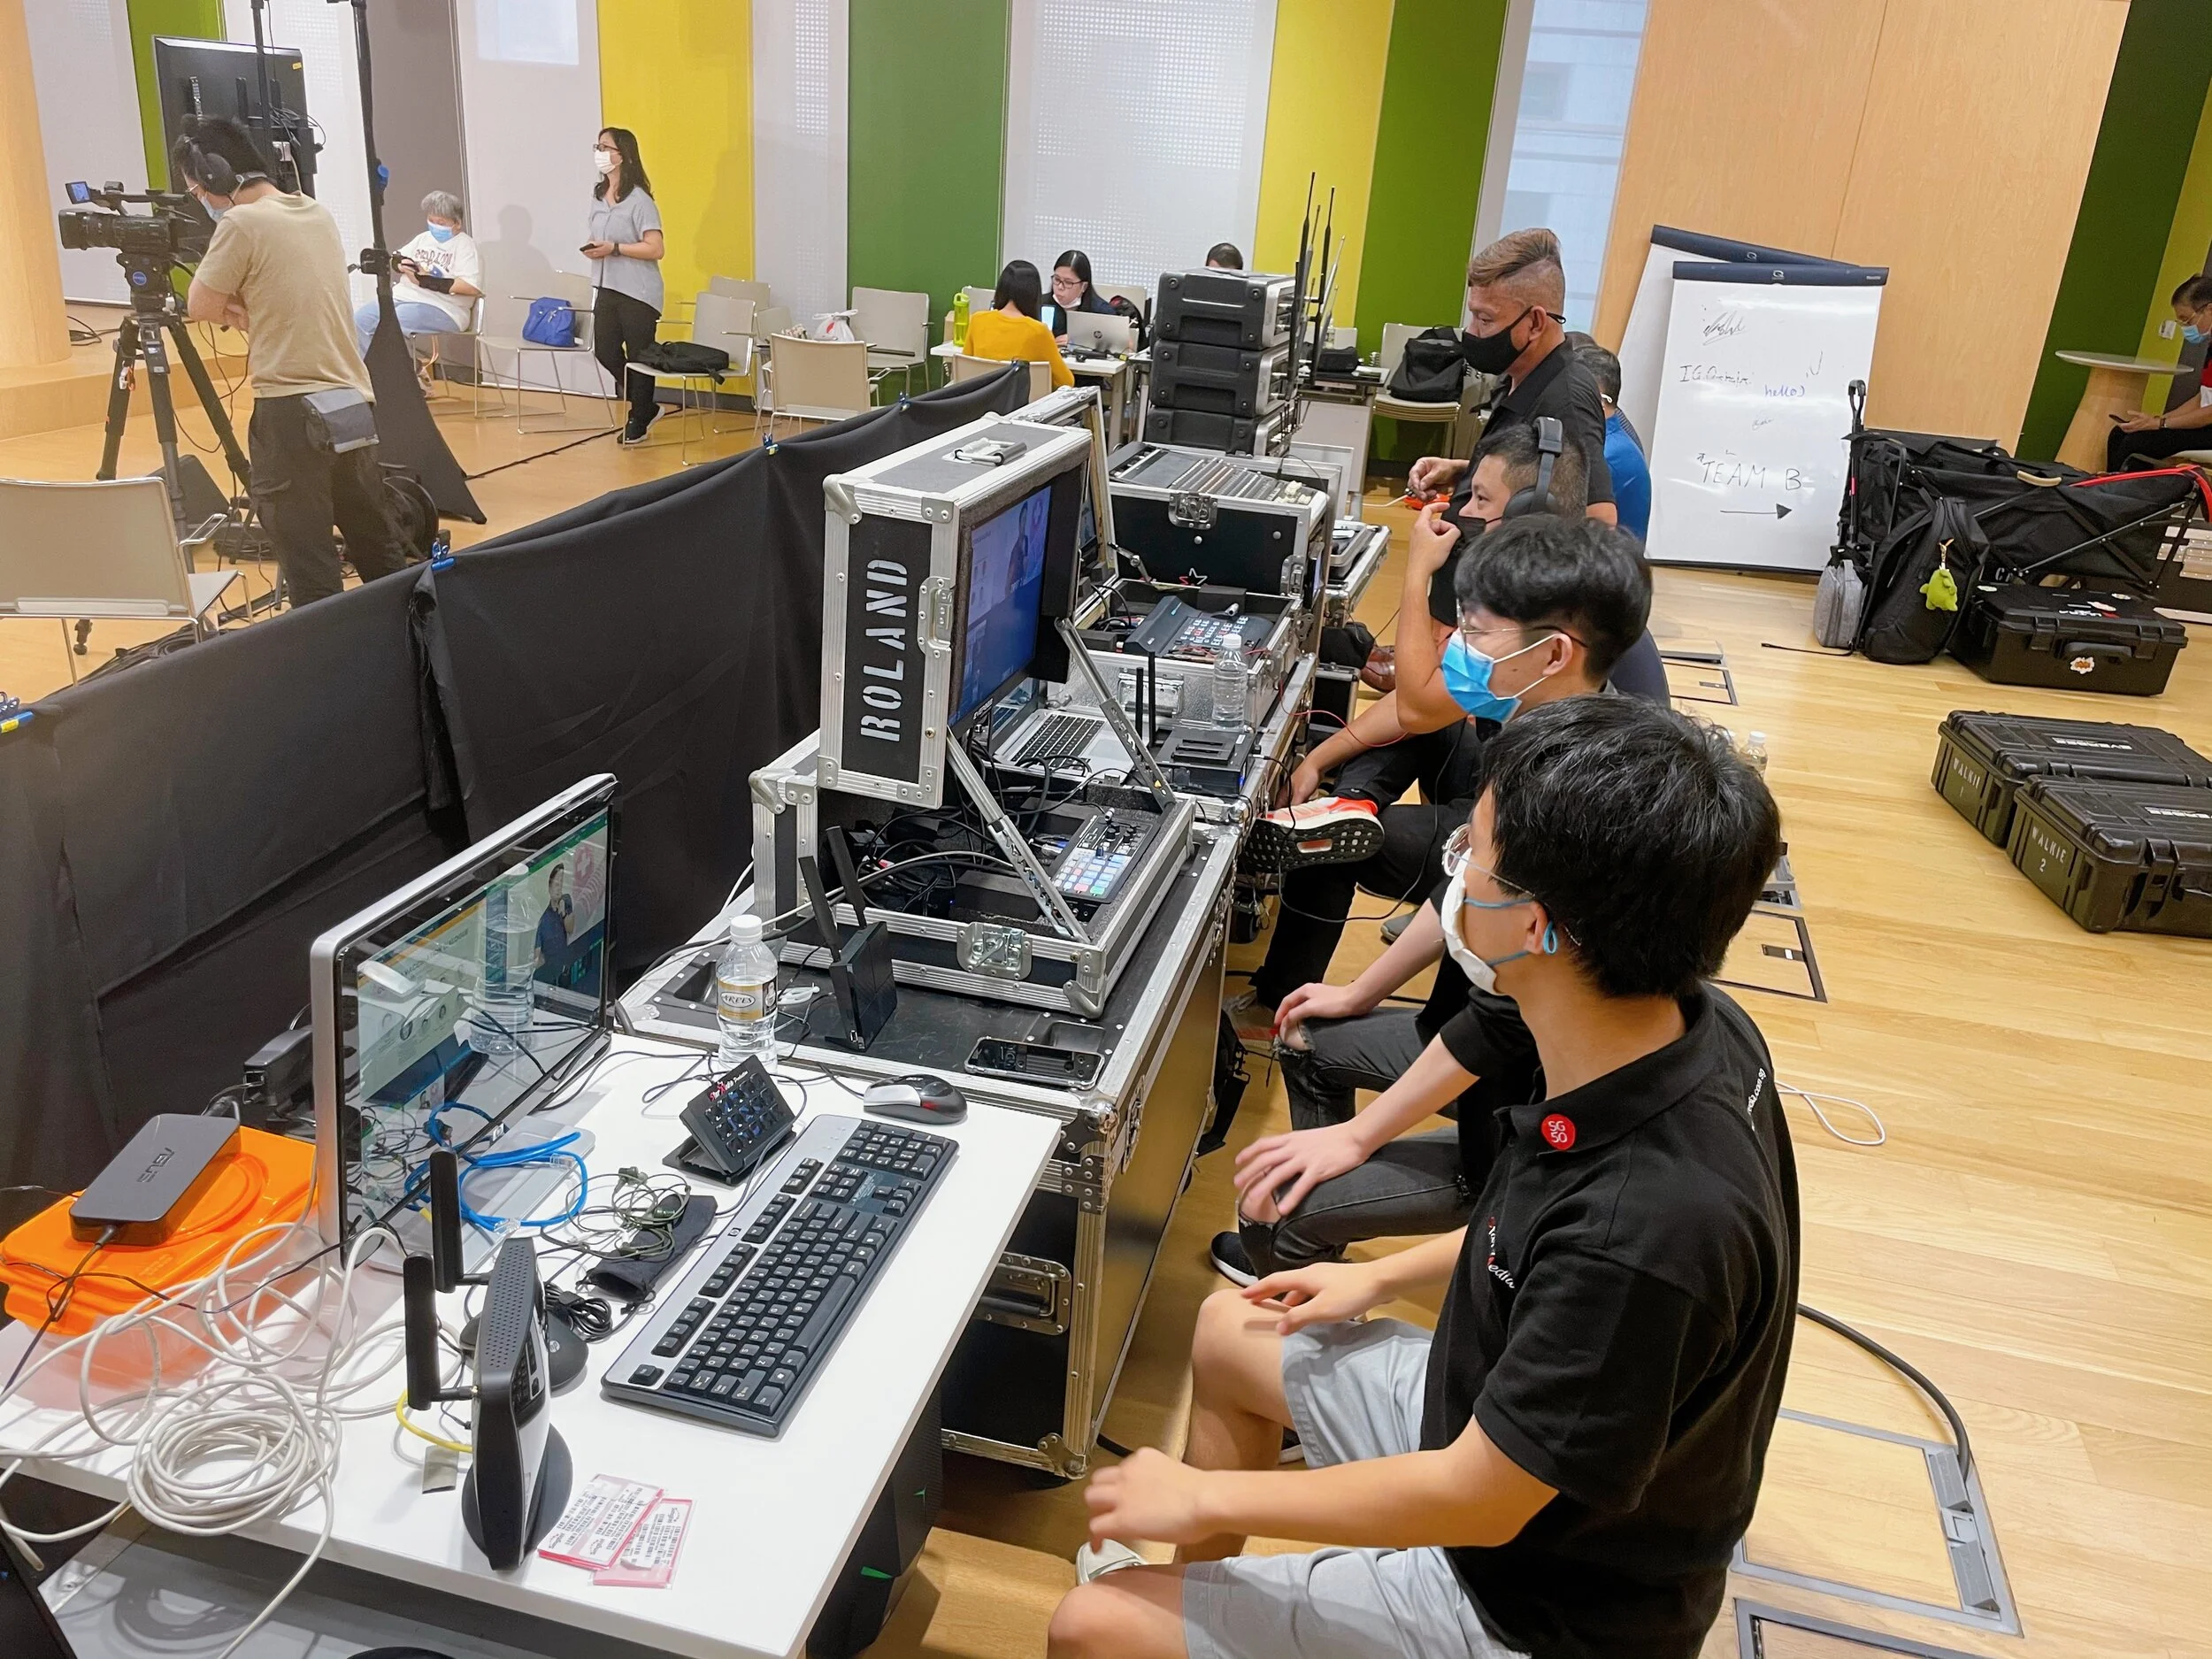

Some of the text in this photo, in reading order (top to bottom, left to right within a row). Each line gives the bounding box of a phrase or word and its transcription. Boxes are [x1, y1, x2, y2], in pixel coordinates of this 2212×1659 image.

[1701, 460, 1802, 491] TEAM B
[860, 558, 908, 742] ROLAND
[2032, 826, 2067, 864] WALKIE
[2039, 857, 2047, 872] 2
[1548, 1120, 1566, 1132] SG
[1550, 1131, 1569, 1143] 50
[136, 1147, 175, 1183] ASUS
